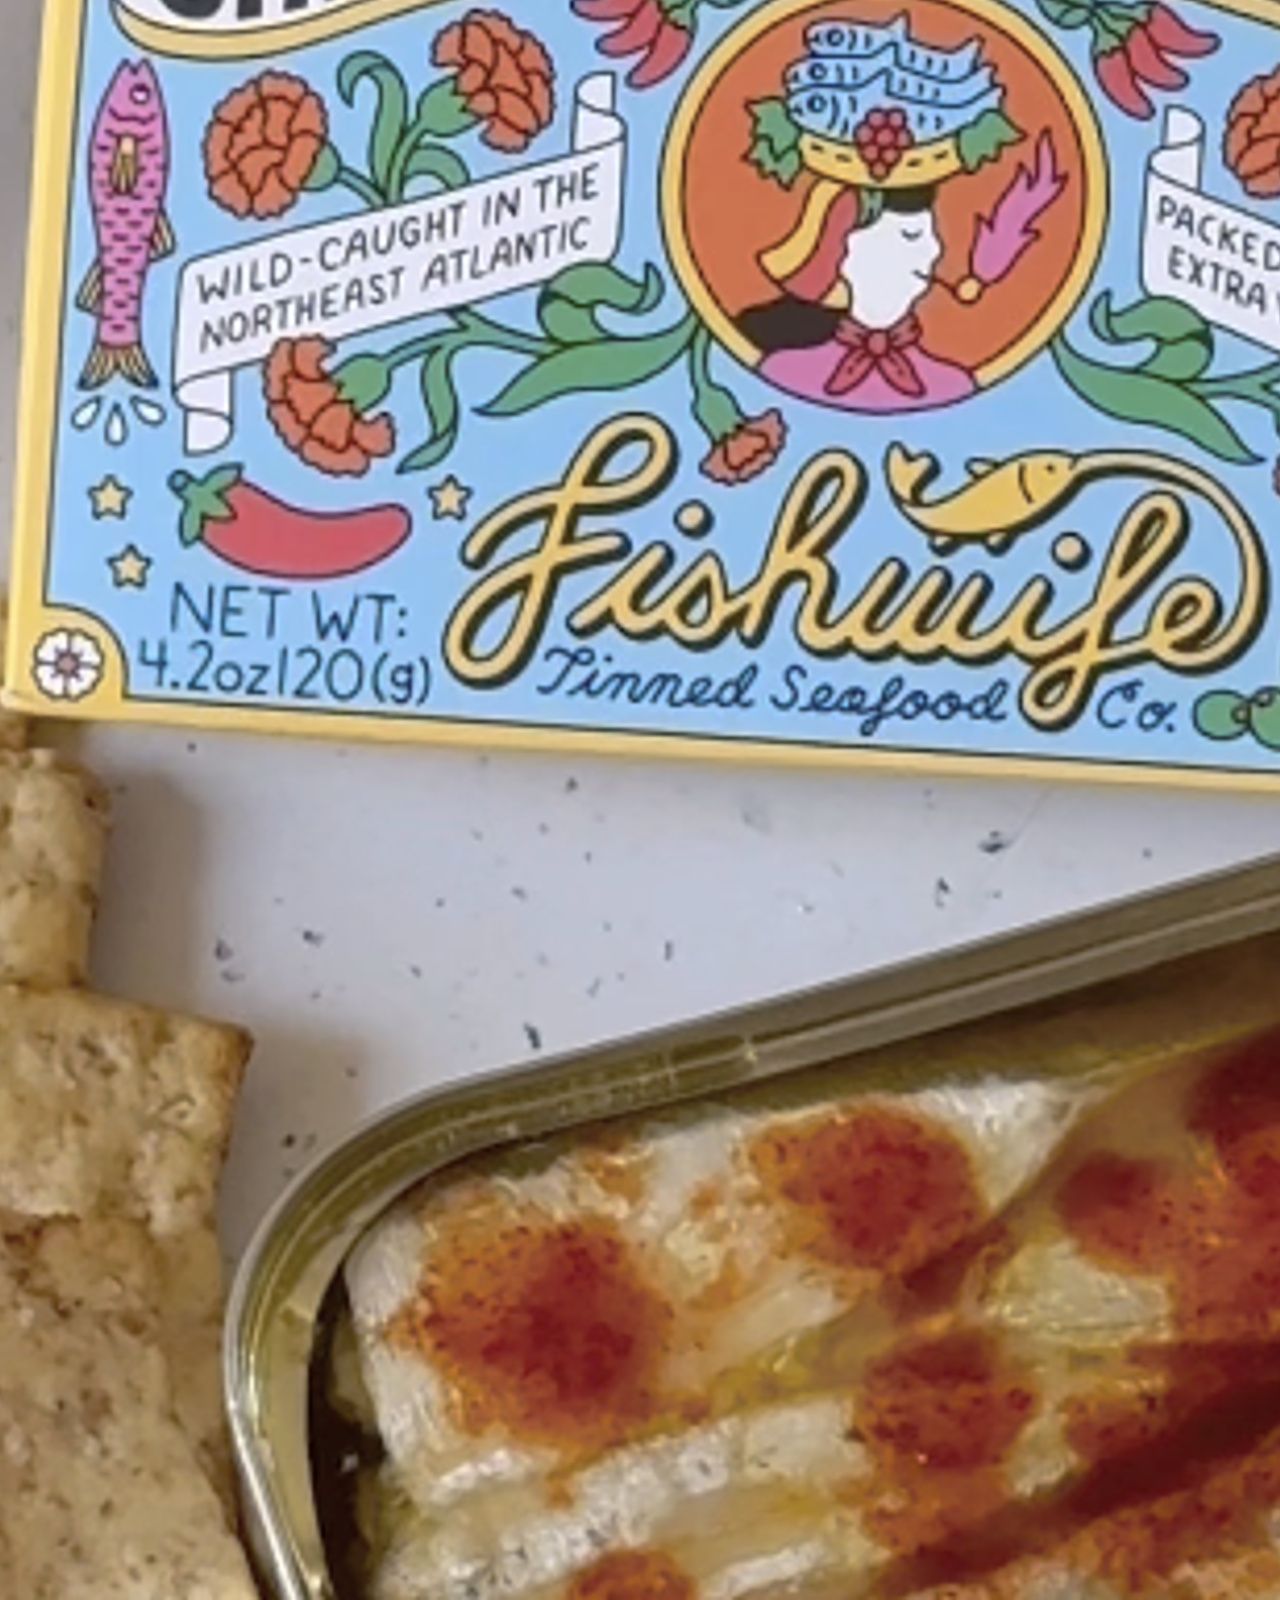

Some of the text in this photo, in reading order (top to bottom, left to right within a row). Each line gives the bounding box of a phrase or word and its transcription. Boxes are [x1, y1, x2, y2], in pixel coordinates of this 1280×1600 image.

[195, 162, 601, 306] WILD-CAUGHT IN THE
[199, 214, 591, 354] NORTHEAST ATLANTIC
[1166, 245, 1267, 314] EXTRA
[170, 580, 408, 645] NET WT:
[442, 411, 1270, 732] Fishwife
[535, 647, 1178, 738] Tinned Seafood Co.
